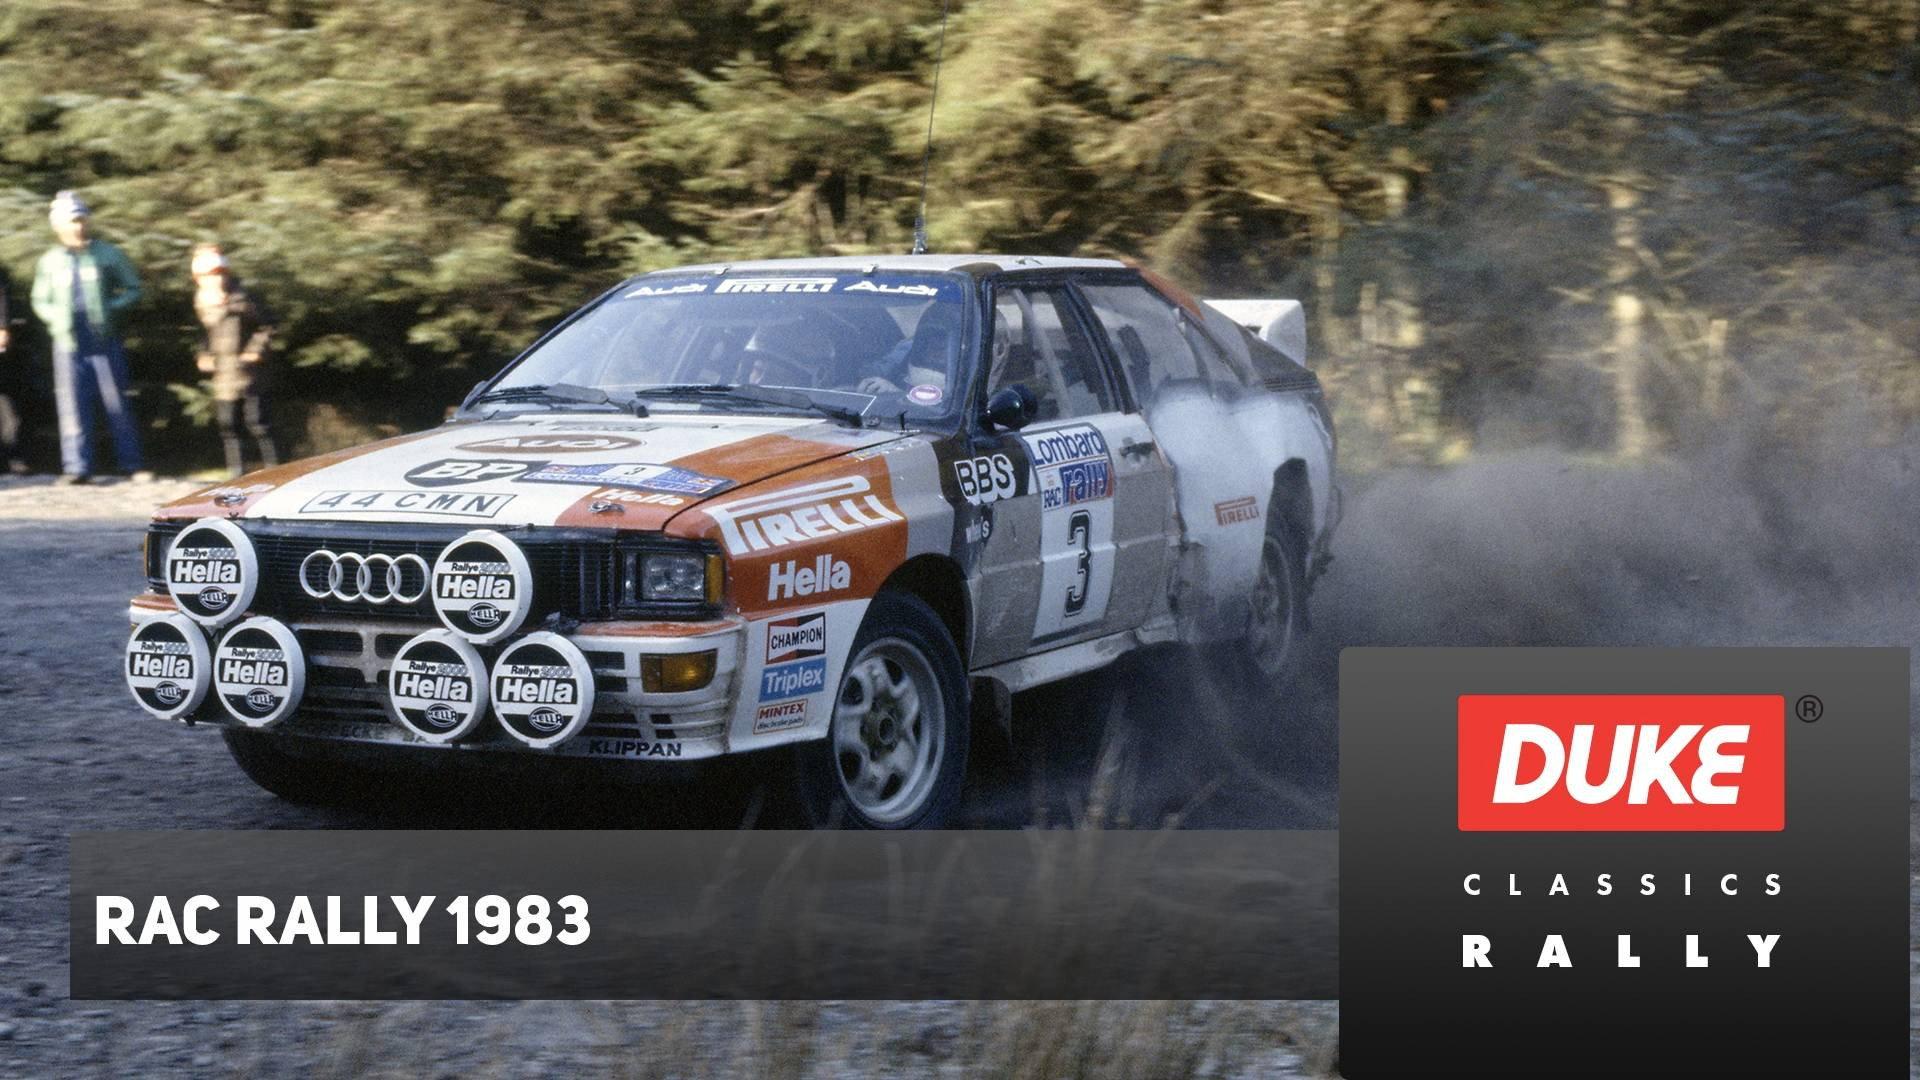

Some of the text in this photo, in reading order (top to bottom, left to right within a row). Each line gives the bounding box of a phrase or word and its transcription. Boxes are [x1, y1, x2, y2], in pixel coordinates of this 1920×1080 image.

[624, 278, 938, 299] Audi PIRELLI Audi
[407, 462, 528, 480] BP
[954, 454, 1017, 505] BBS
[1062, 463, 1109, 505] rally
[318, 492, 500, 512] 44 CMN
[1215, 496, 1259, 527] PIRELLI
[702, 475, 904, 556] PIRELLI
[174, 561, 237, 582] Hella
[1063, 509, 1092, 618] 3
[441, 575, 511, 598] Hella
[768, 553, 851, 601] Hella
[770, 627, 822, 649] CHAMPION
[133, 654, 190, 678] Hella
[222, 660, 285, 685] Hella
[399, 673, 468, 700] Hella
[501, 678, 573, 702] Hella
[764, 666, 823, 695] Triplex
[760, 702, 804, 719] MINTEX
[589, 740, 682, 756] KLIPPAN
